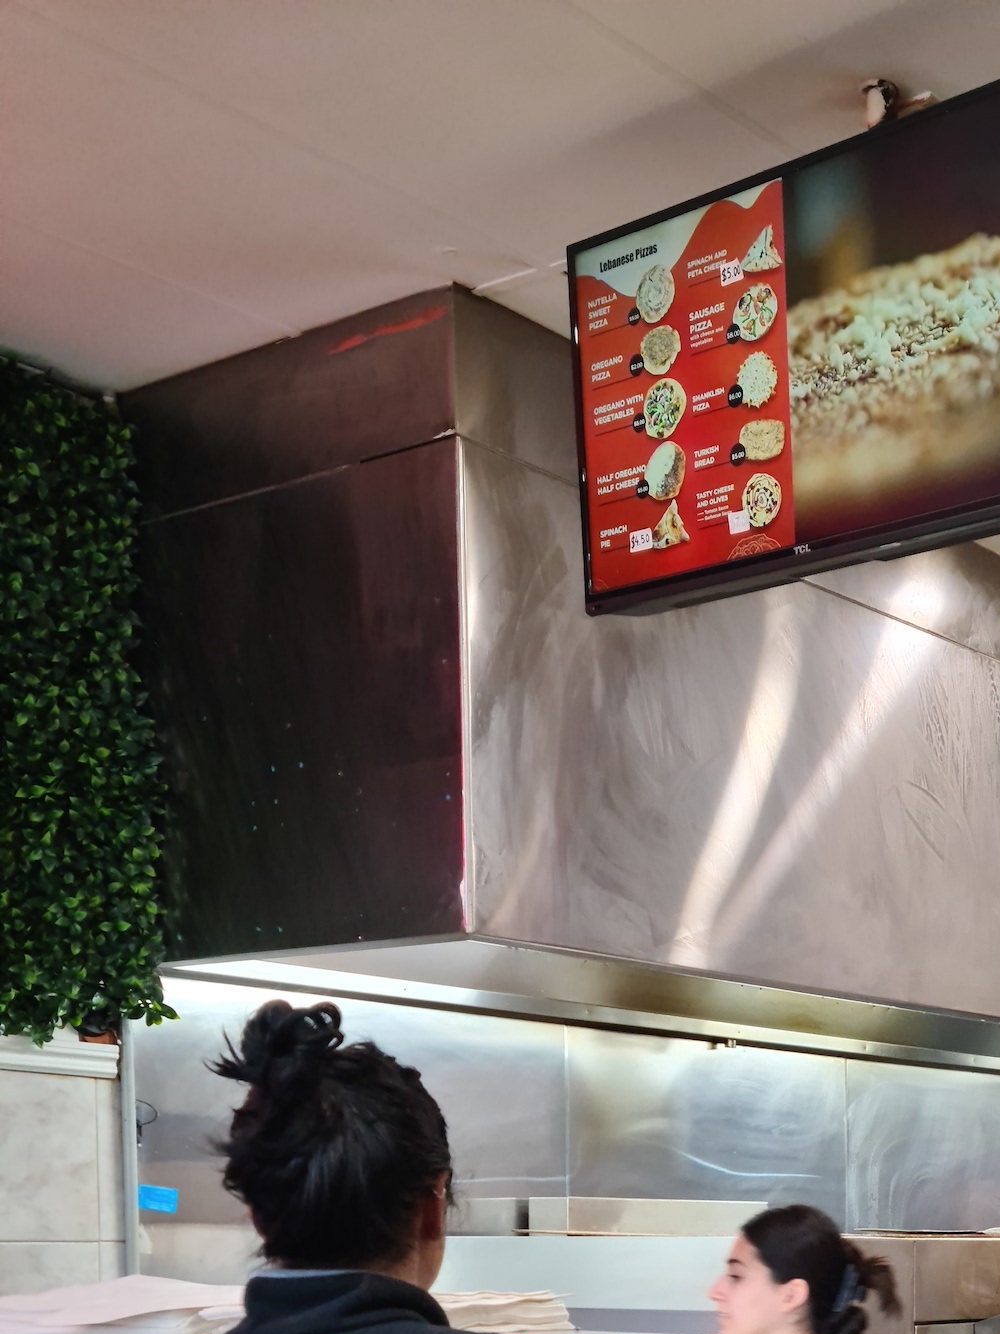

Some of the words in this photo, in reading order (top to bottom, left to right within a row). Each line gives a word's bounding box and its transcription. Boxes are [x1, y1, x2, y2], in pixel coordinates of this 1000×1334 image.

[600, 252, 634, 273] Lebanese
[635, 244, 658, 260] Pizzas
[687, 254, 713, 269] SPINACH
[714, 249, 728, 260] AND
[688, 268, 703, 279] FETA
[722, 264, 740, 282] $5.00
[588, 293, 618, 309] NUTELLA
[588, 306, 611, 320] SWEET
[689, 302, 725, 322] SAUSAGE
[589, 318, 608, 331] PIZZA
[689, 319, 713, 334] PIZZA
[591, 355, 624, 371] OREGANO
[592, 370, 611, 382] PIZZA
[692, 387, 724, 402] SHANKLISH
[594, 400, 626, 416] OREGANO
[626, 394, 644, 406] WITH
[692, 402, 710, 412] PIZZA
[594, 408, 634, 426] VEGETABLES
[694, 444, 720, 458] TURKISH
[694, 456, 715, 468] BREAD
[597, 473, 614, 484] HALF
[614, 464, 646, 480] OREGANO
[598, 484, 614, 496] HALF
[696, 489, 713, 500] TASTY
[714, 484, 735, 496] CHEESE
[696, 500, 709, 508] AND
[709, 494, 728, 505] OLIVES
[600, 524, 628, 538] SPINACH
[600, 540, 610, 548] PIE
[630, 534, 650, 550] $4.50
[793, 544, 811, 555] TCL
